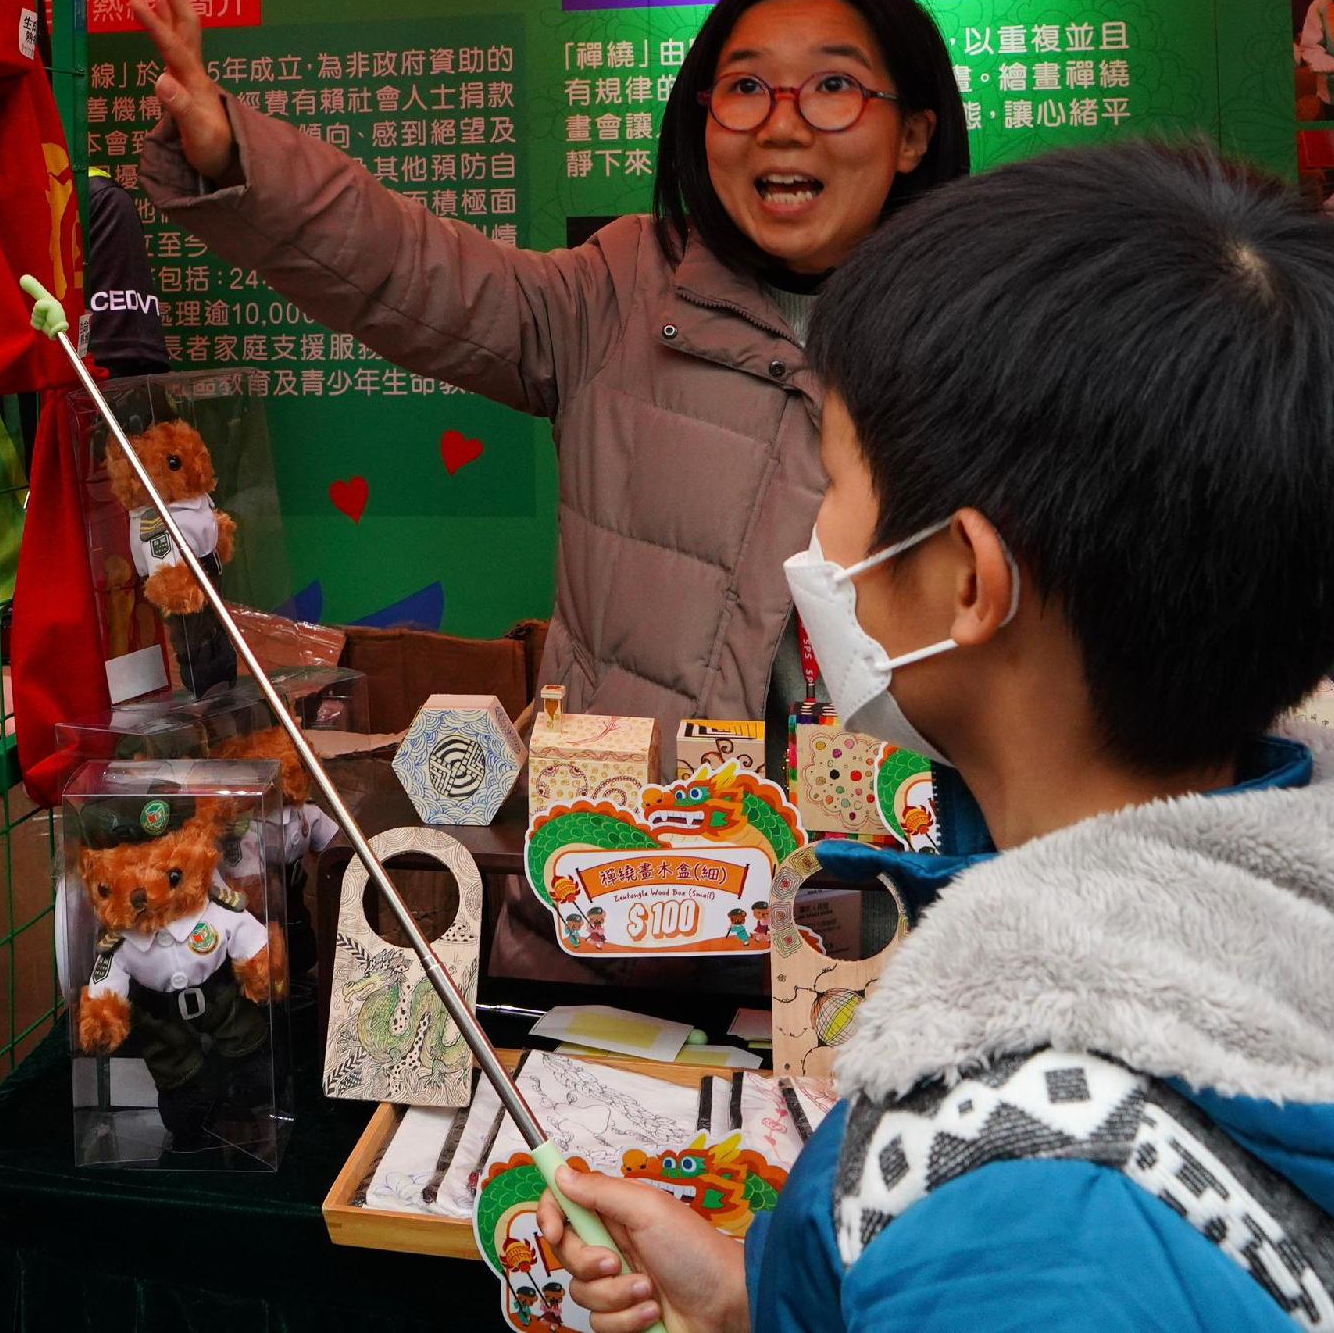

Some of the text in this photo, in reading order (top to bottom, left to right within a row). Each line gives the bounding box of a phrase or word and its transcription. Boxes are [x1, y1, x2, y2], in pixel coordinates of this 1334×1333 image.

[565, 112, 662, 143] 畫會讓
[566, 148, 652, 179] 靜下來
[649, 888, 671, 897] Wood
[672, 888, 687, 898] Box
[627, 898, 701, 943] $100
